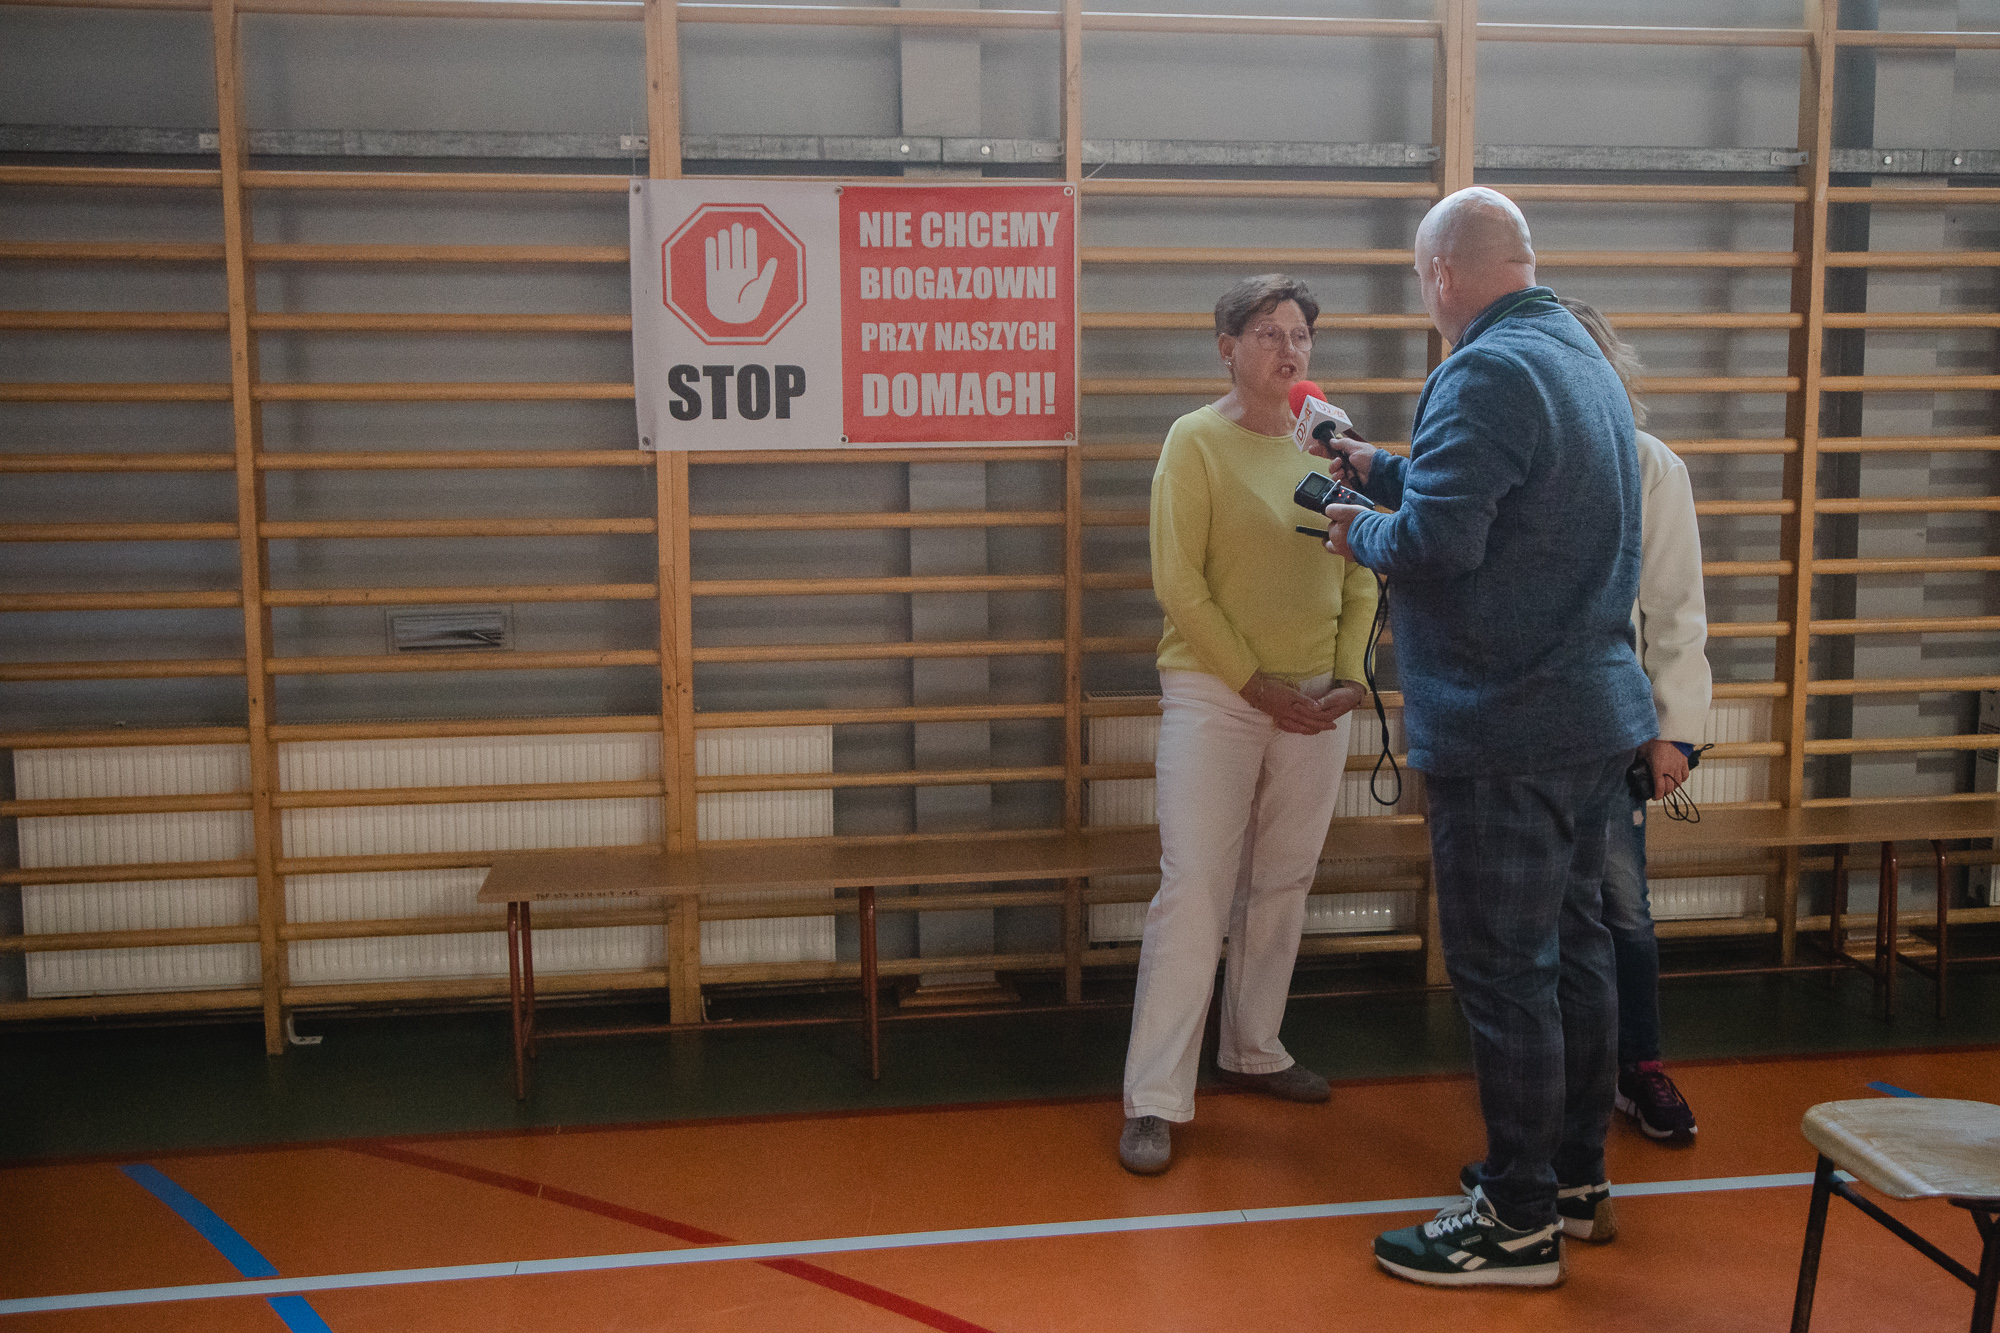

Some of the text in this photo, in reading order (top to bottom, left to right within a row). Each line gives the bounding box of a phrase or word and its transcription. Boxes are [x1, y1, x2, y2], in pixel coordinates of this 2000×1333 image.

[859, 211, 1060, 248] NIE CHCEMY
[860, 266, 1056, 300] BIOGAZOWNI
[861, 321, 1056, 352] PRZY NASZYCH
[667, 364, 807, 421] STOP
[862, 371, 1056, 418] DOMACH!
